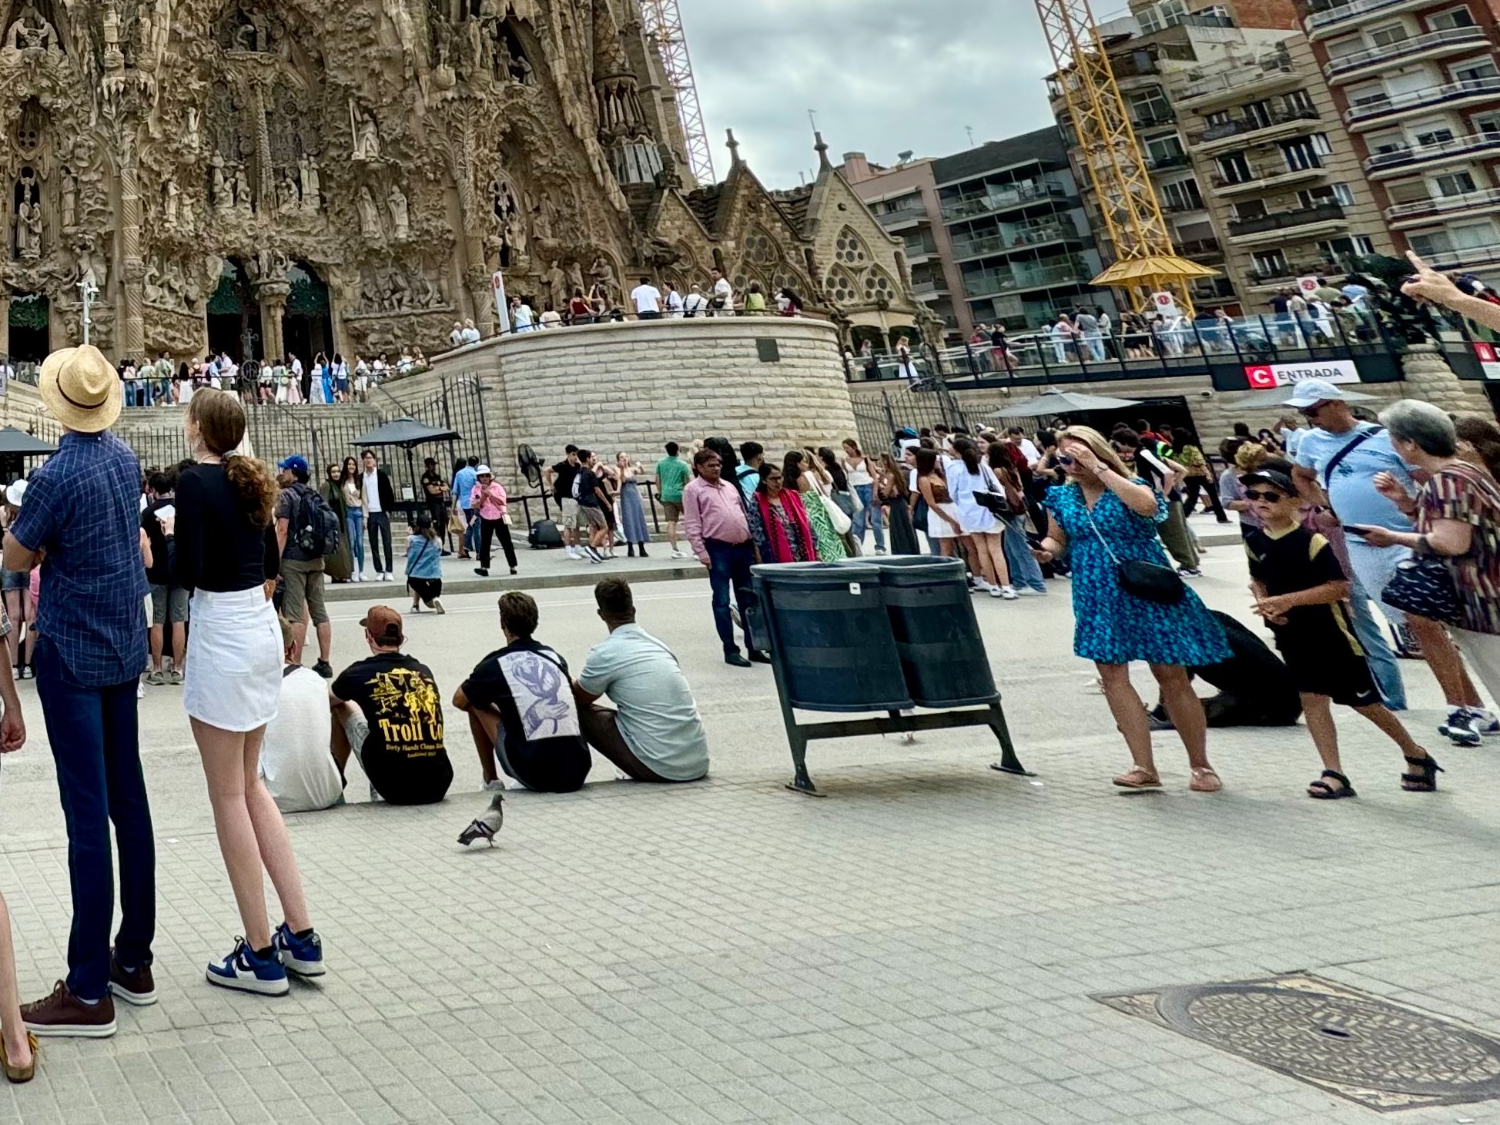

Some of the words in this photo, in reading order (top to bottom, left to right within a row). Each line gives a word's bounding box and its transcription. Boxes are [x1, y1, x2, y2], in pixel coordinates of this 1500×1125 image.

[1253, 369, 1271, 384] C
[1277, 368, 1344, 380] ENTRADA
[378, 718, 424, 742] Troll
